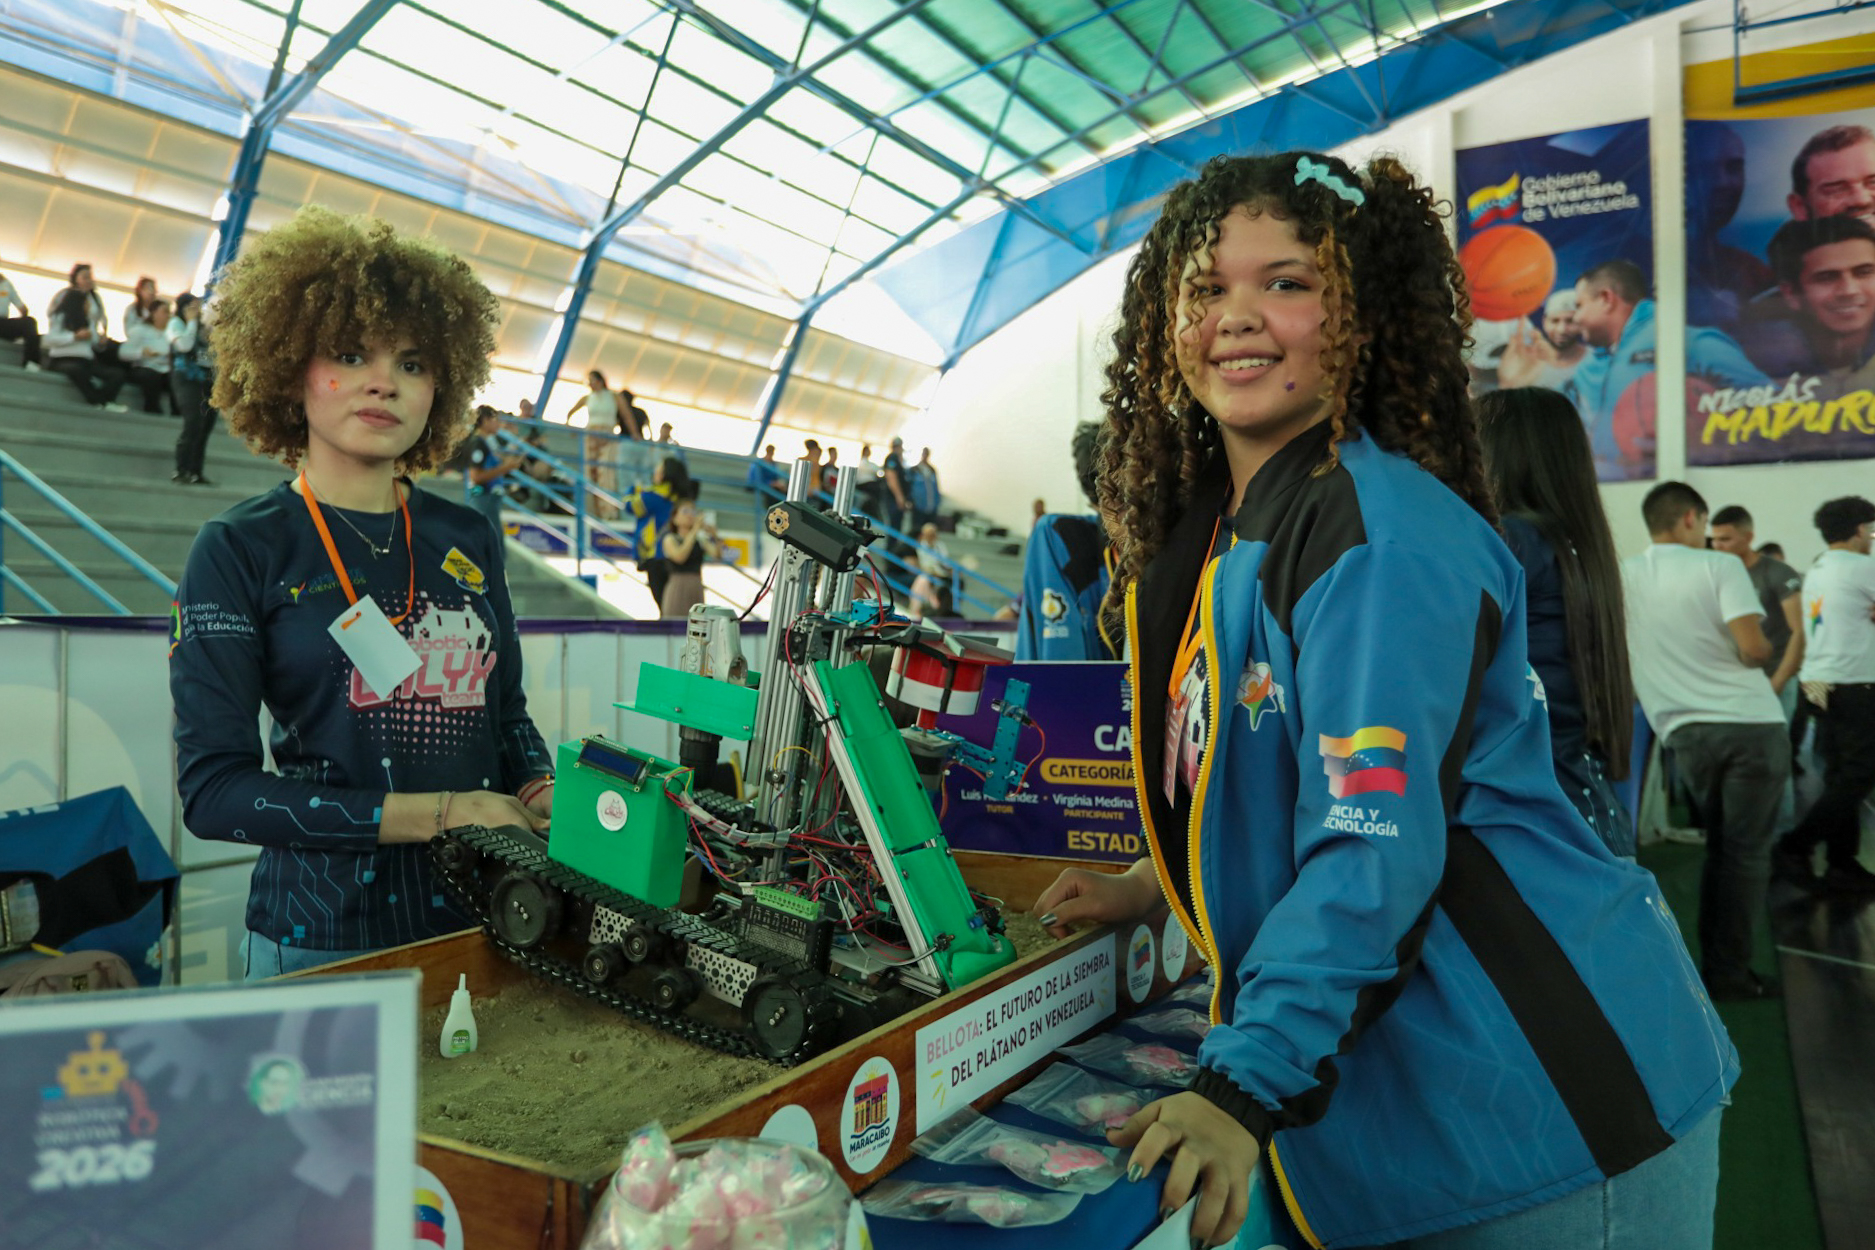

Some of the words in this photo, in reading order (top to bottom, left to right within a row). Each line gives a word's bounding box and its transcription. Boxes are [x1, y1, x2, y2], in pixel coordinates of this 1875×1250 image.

[1522, 170, 1600, 193] Gobierno
[1522, 180, 1627, 208] Bolivariano
[1522, 210, 1546, 222] de
[1548, 193, 1639, 219] Venezuela
[1698, 372, 1821, 413] NICOLÁS
[190, 612, 217, 622] Poder
[407, 634, 468, 651] obotic
[442, 691, 484, 705] team
[1049, 763, 1135, 781] CATEGORÍA
[961, 789, 982, 801] Luis
[1095, 795, 1134, 809] Medina
[986, 804, 1014, 814] TUTOR
[1064, 809, 1125, 821] PARTICIPANTE
[1368, 809, 1380, 822] Y
[1321, 816, 1399, 837] ECNOLOGÍA
[927, 1018, 983, 1065] BELLOTA:
[986, 1009, 998, 1032] EL
[1002, 985, 1042, 1024] FUTURO
[1046, 976, 1057, 999] DE
[1060, 970, 1072, 991] LA
[1074, 951, 1110, 984] SIEMBRA
[951, 1058, 973, 1088] DEL
[977, 1026, 1026, 1073] PLÁTANO
[1030, 1017, 1042, 1041] EN
[1045, 988, 1095, 1031] VENEZUELA
[849, 1126, 890, 1154] MARACAIBO
[29, 1140, 157, 1190] 2026
